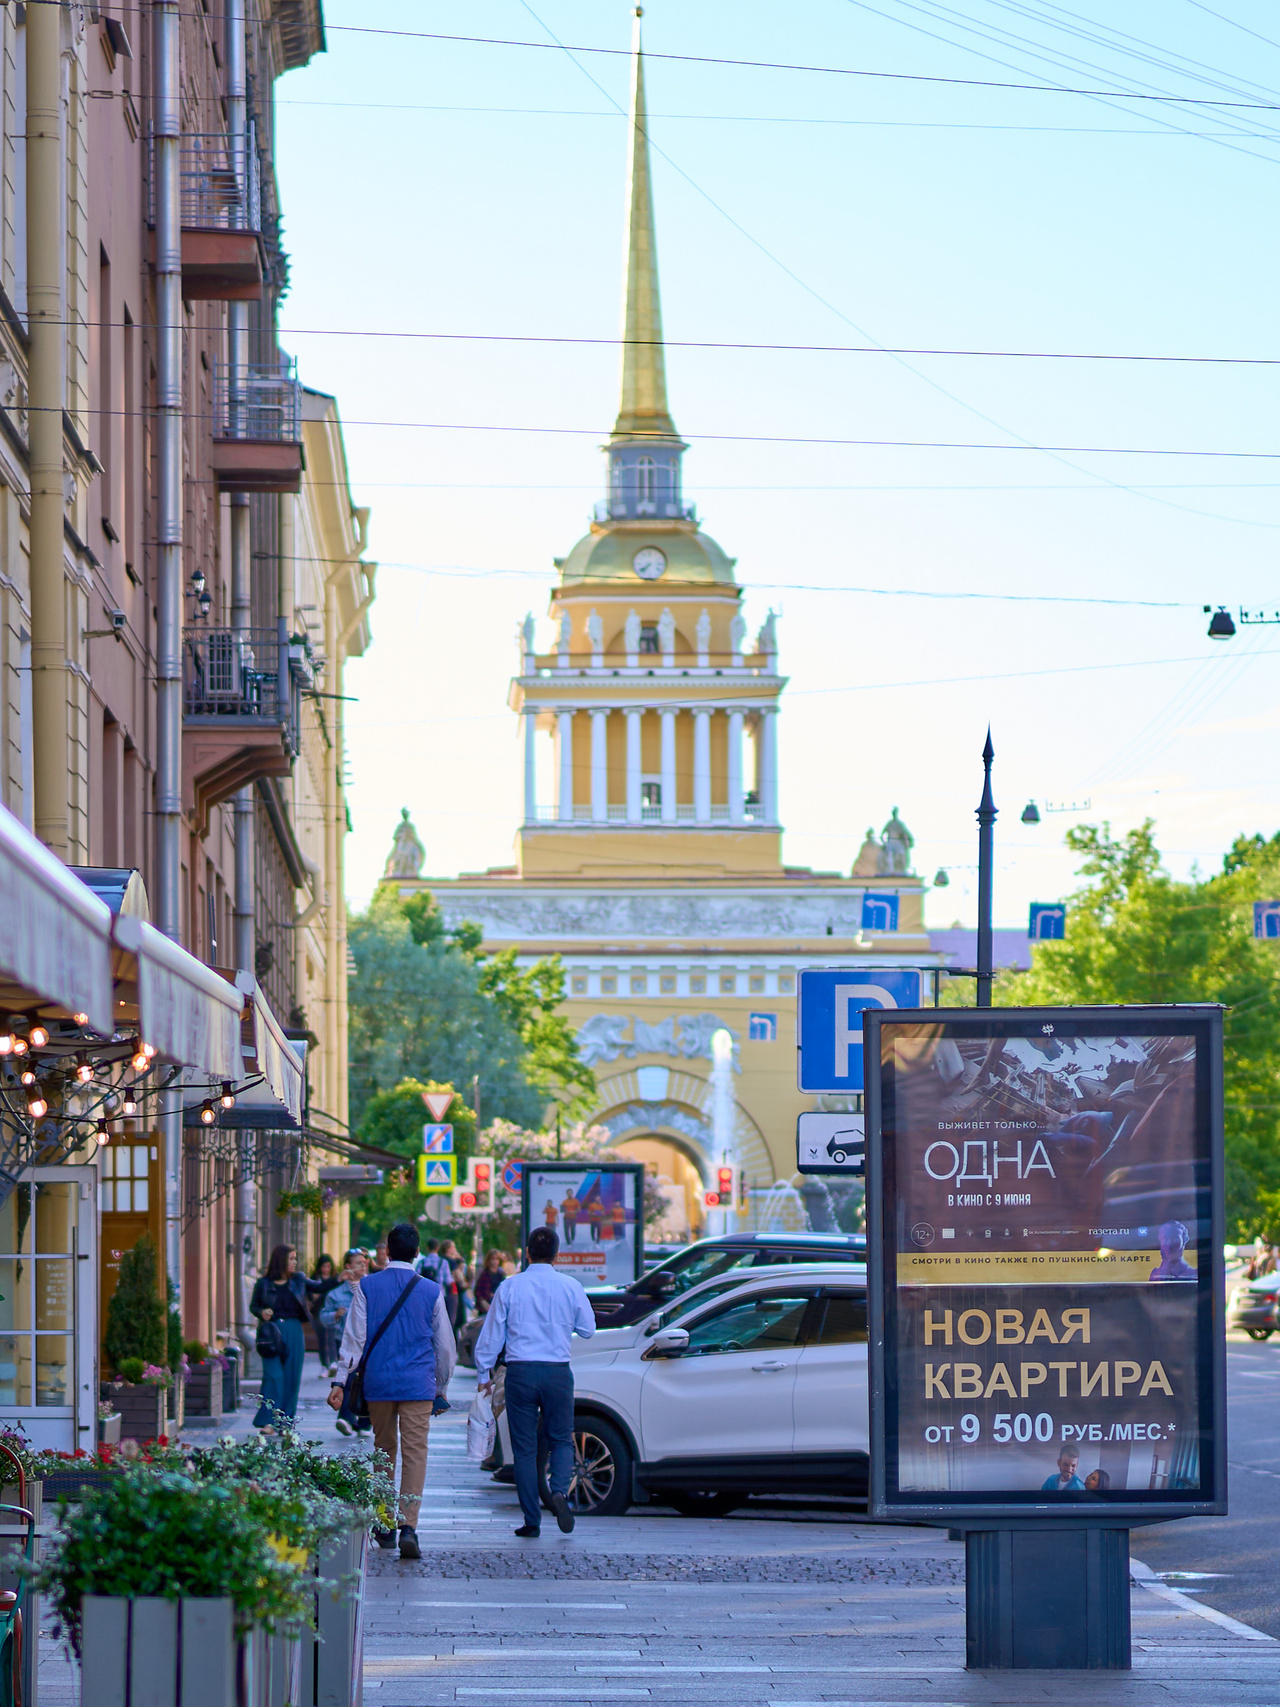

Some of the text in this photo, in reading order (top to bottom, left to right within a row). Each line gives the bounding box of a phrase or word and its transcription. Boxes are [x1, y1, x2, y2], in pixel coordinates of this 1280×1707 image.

[834, 983, 899, 1078] P
[938, 1120, 1046, 1130] ВЫЖИВЕТ ТОЛЬКО...
[924, 1140, 1057, 1188] ОДНА
[948, 1193, 1031, 1206] В КИНО С 9 ИЮНЯ
[916, 1230, 931, 1240] 12+
[1048, 1255, 1117, 1263] ПУШКИНСКОЙ
[924, 1308, 1091, 1345] НОВАЯ
[924, 1360, 1174, 1399] КВАРТИРА
[925, 1425, 955, 1443] ОТ
[961, 1413, 980, 1443] 9
[993, 1412, 1054, 1443] 500
